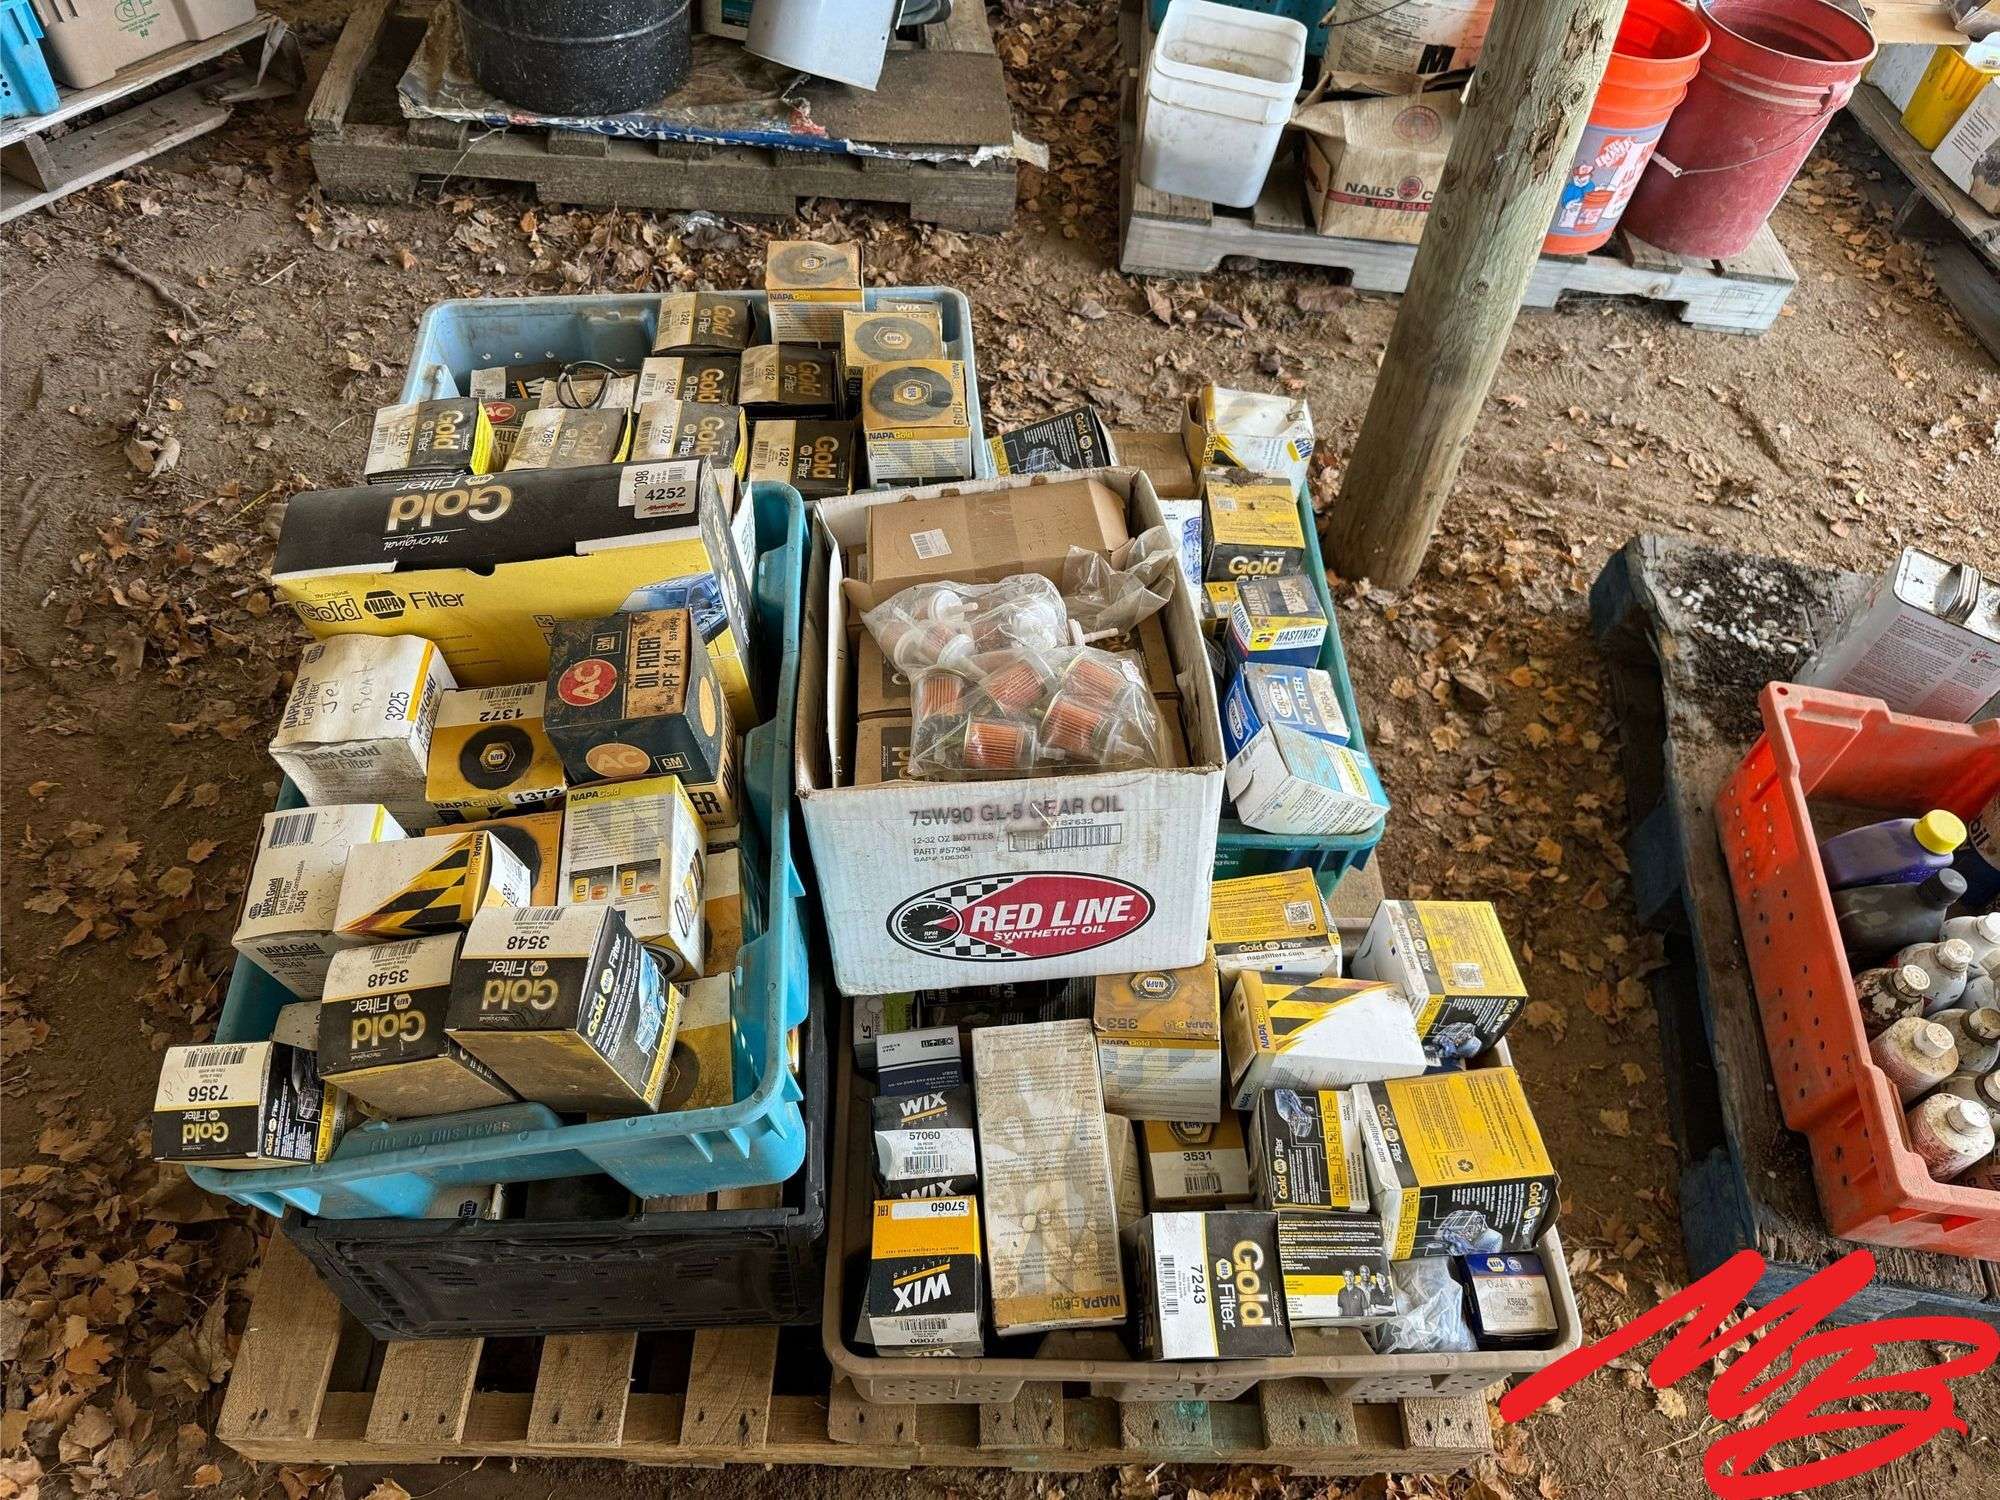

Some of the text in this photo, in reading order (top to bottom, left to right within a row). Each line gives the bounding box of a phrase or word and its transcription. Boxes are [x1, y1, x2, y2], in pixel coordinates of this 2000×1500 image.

[1345, 181, 1435, 201] NAILS C
[770, 293, 793, 301] NAPA
[895, 304, 921, 312] WIX
[680, 311, 690, 326] 1242
[712, 305, 736, 338] Gold
[765, 364, 775, 380] 1242
[799, 361, 822, 396] Gold
[665, 378, 677, 394] 1242
[698, 368, 725, 403] Gold
[952, 401, 964, 426] 1049
[1075, 412, 1088, 434] Gold
[433, 410, 464, 450] Gold
[660, 424, 673, 445] 1372
[695, 416, 725, 457] Gold
[869, 432, 894, 440] NAPA
[779, 447, 790, 468] 1242
[813, 436, 840, 479] Gold
[1203, 436, 1217, 464] 3548
[797, 456, 813, 480] Filter
[397, 477, 462, 493] Filter
[645, 487, 686, 500] 4252
[386, 486, 512, 531] Gold
[1228, 555, 1285, 575] Gold
[297, 597, 362, 622] Gold
[369, 591, 464, 614] NAPA Filter
[1231, 603, 1251, 638] HASTINGS
[595, 637, 616, 651] GM
[1277, 627, 1321, 642] HASTINGS
[634, 635, 662, 691] OIL FILTER
[662, 649, 682, 690] PF 141
[572, 664, 602, 700] AC
[283, 677, 311, 730] NAPA Gold
[298, 683, 320, 727] Fuel Filter
[385, 691, 410, 721] 3225
[1270, 682, 1289, 716] CIRCLE
[1293, 676, 1317, 726] OIL FILTER
[479, 708, 524, 722] 1372
[340, 745, 381, 759] Gold
[599, 751, 645, 772] AC
[662, 757, 683, 769] GM
[306, 757, 374, 771] Fuel Filter
[514, 788, 560, 803] 1372
[571, 791, 599, 801] NAPA
[909, 807, 973, 827] 75W90
[981, 803, 1023, 822] GL-5
[1092, 795, 1124, 813] OIL
[473, 834, 484, 858] NAPA
[953, 833, 994, 842] BOTTLES
[914, 848, 937, 856] PART
[261, 878, 279, 917] NAPA Gold
[276, 880, 293, 915] Fuel Filter
[294, 890, 309, 913] 3548
[970, 894, 1135, 933] RED LINE
[993, 923, 1106, 942] SYNTHETIC OIL
[1407, 917, 1423, 940] Gold
[256, 942, 321, 955] NAPA Gold
[507, 935, 550, 950] 3548
[608, 933, 622, 969] Filter
[1238, 942, 1303, 953] Gold Filter
[1246, 951, 1306, 962] napafilters.com
[367, 969, 410, 988] 3548
[488, 960, 528, 977] Filter
[481, 979, 559, 1011] Gold
[1145, 979, 1165, 989] NAPA
[351, 996, 391, 1013] Filter
[587, 993, 607, 1038] Gold
[351, 1010, 427, 1050] Gold
[1258, 1024, 1271, 1049] NAPA
[1101, 1039, 1129, 1047] NAPA
[188, 1084, 229, 1102] 7356
[900, 1091, 947, 1116] WIX
[182, 1111, 207, 1122] Filter
[1183, 1121, 1202, 1130] NAPA
[182, 1121, 230, 1145] Gold
[909, 1131, 941, 1141] 57060
[1364, 1109, 1388, 1164] napafilters.com
[1376, 1102, 1405, 1164] Gold Filter
[264, 1134, 275, 1156] Gold
[1183, 1151, 1213, 1162] 3531
[1275, 1137, 1288, 1200] Gold Filter
[901, 1178, 957, 1198] WIX
[1528, 1182, 1544, 1208] Gold
[930, 1202, 966, 1213] 57060
[892, 1258, 951, 1280] FILTERS
[892, 1272, 952, 1312] WIX
[1190, 1264, 1207, 1305] 7243
[1232, 1240, 1273, 1328] Gold
[1081, 1294, 1121, 1308] NAPA
[1217, 1283, 1237, 1328] Filter
